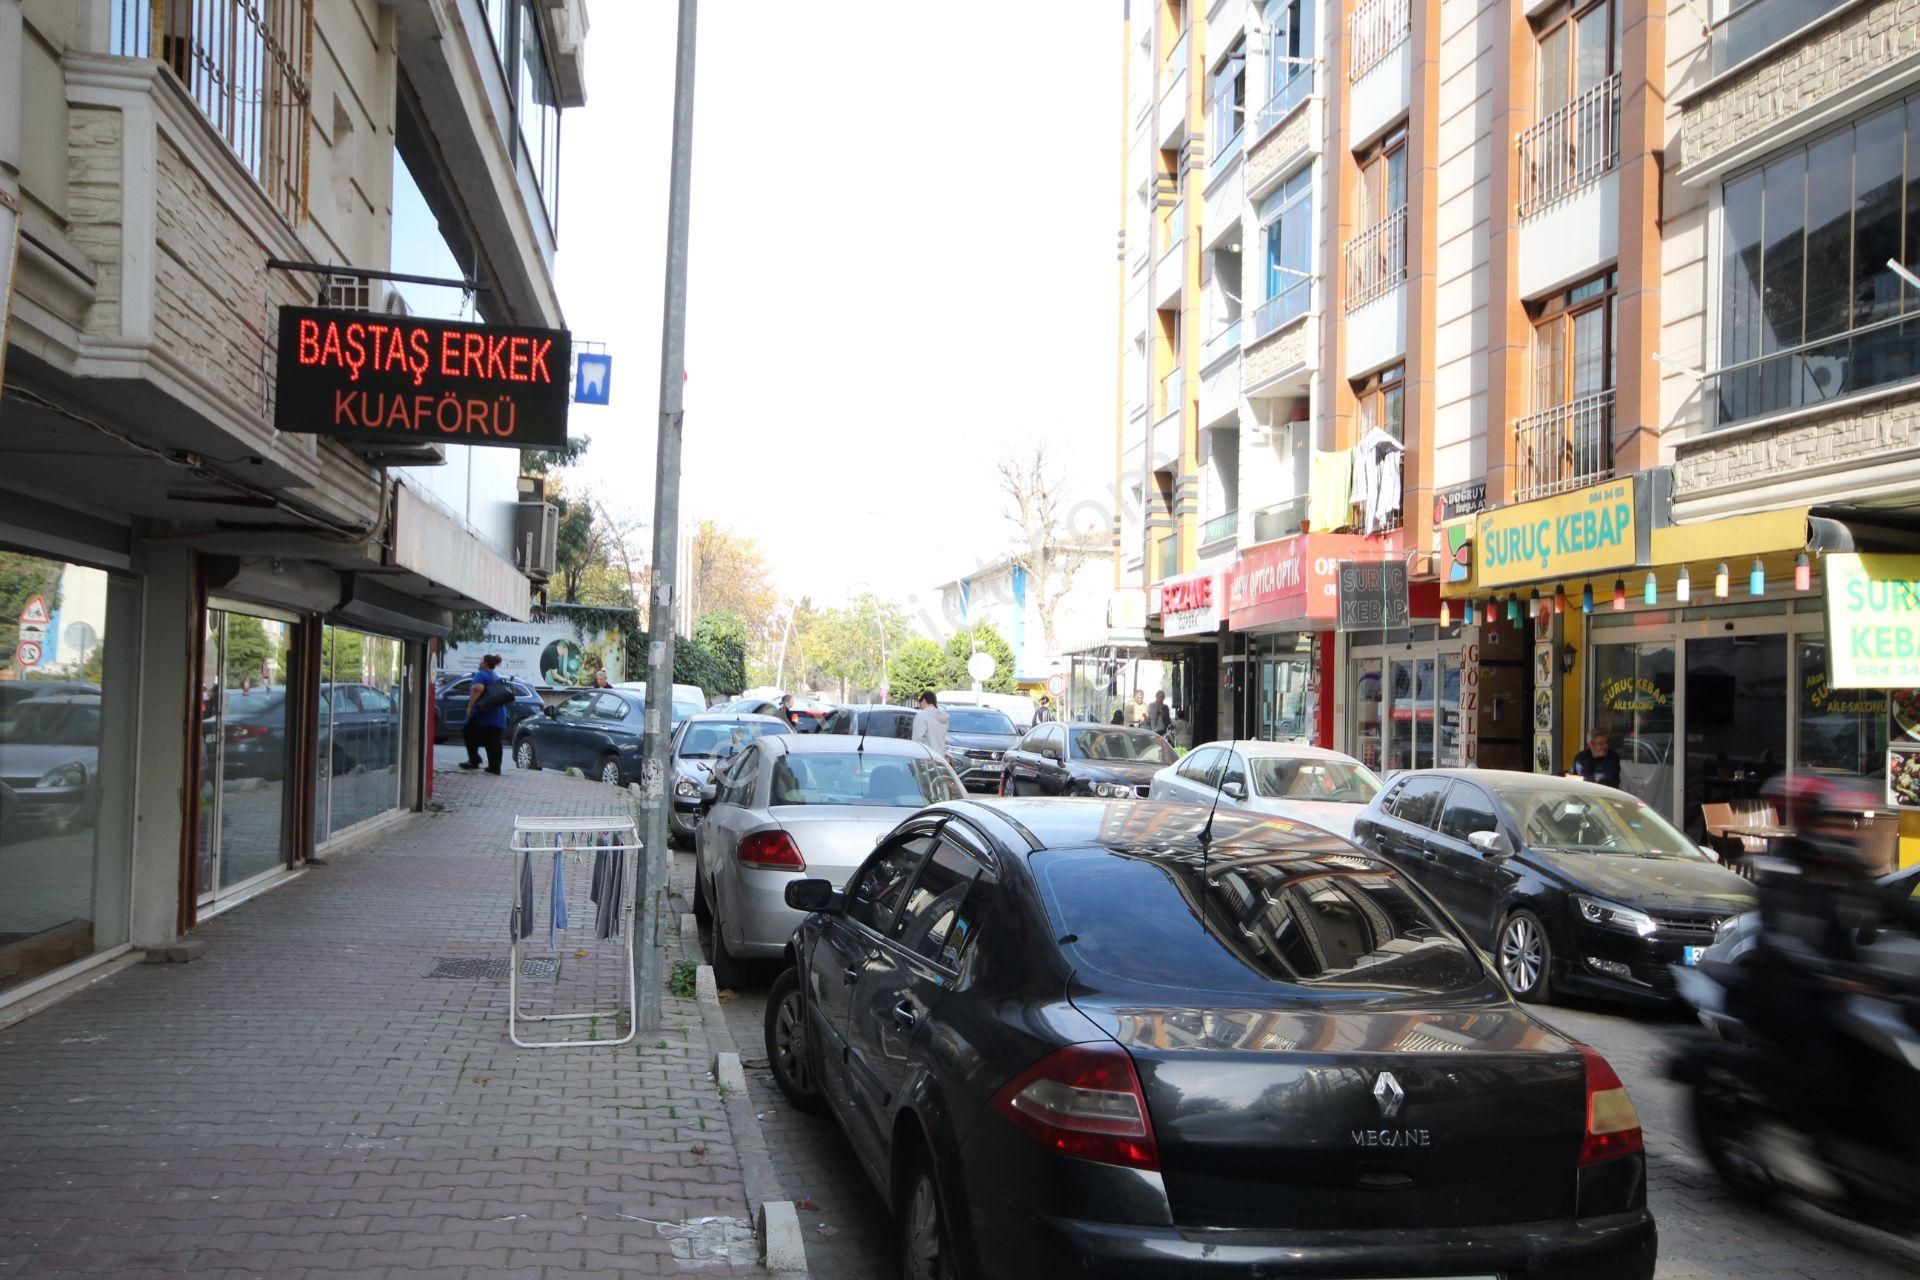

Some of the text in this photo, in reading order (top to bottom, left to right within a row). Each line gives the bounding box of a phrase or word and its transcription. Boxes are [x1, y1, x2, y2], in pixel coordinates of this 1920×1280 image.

[299, 319, 552, 385] BAŞTAŞ ERKEK
[334, 390, 516, 436] KUAFÖRÜ
[1448, 485, 1487, 505] DOĞRUY
[1485, 502, 1630, 570] SURUÇ KEBAP
[1343, 568, 1403, 595] SURUÇ
[1343, 600, 1405, 624] KEBAP
[484, 633, 540, 646] STLARIMIZ
[1466, 644, 1479, 760] GÖZLÜ
[1351, 1129, 1431, 1147] MEGANE
